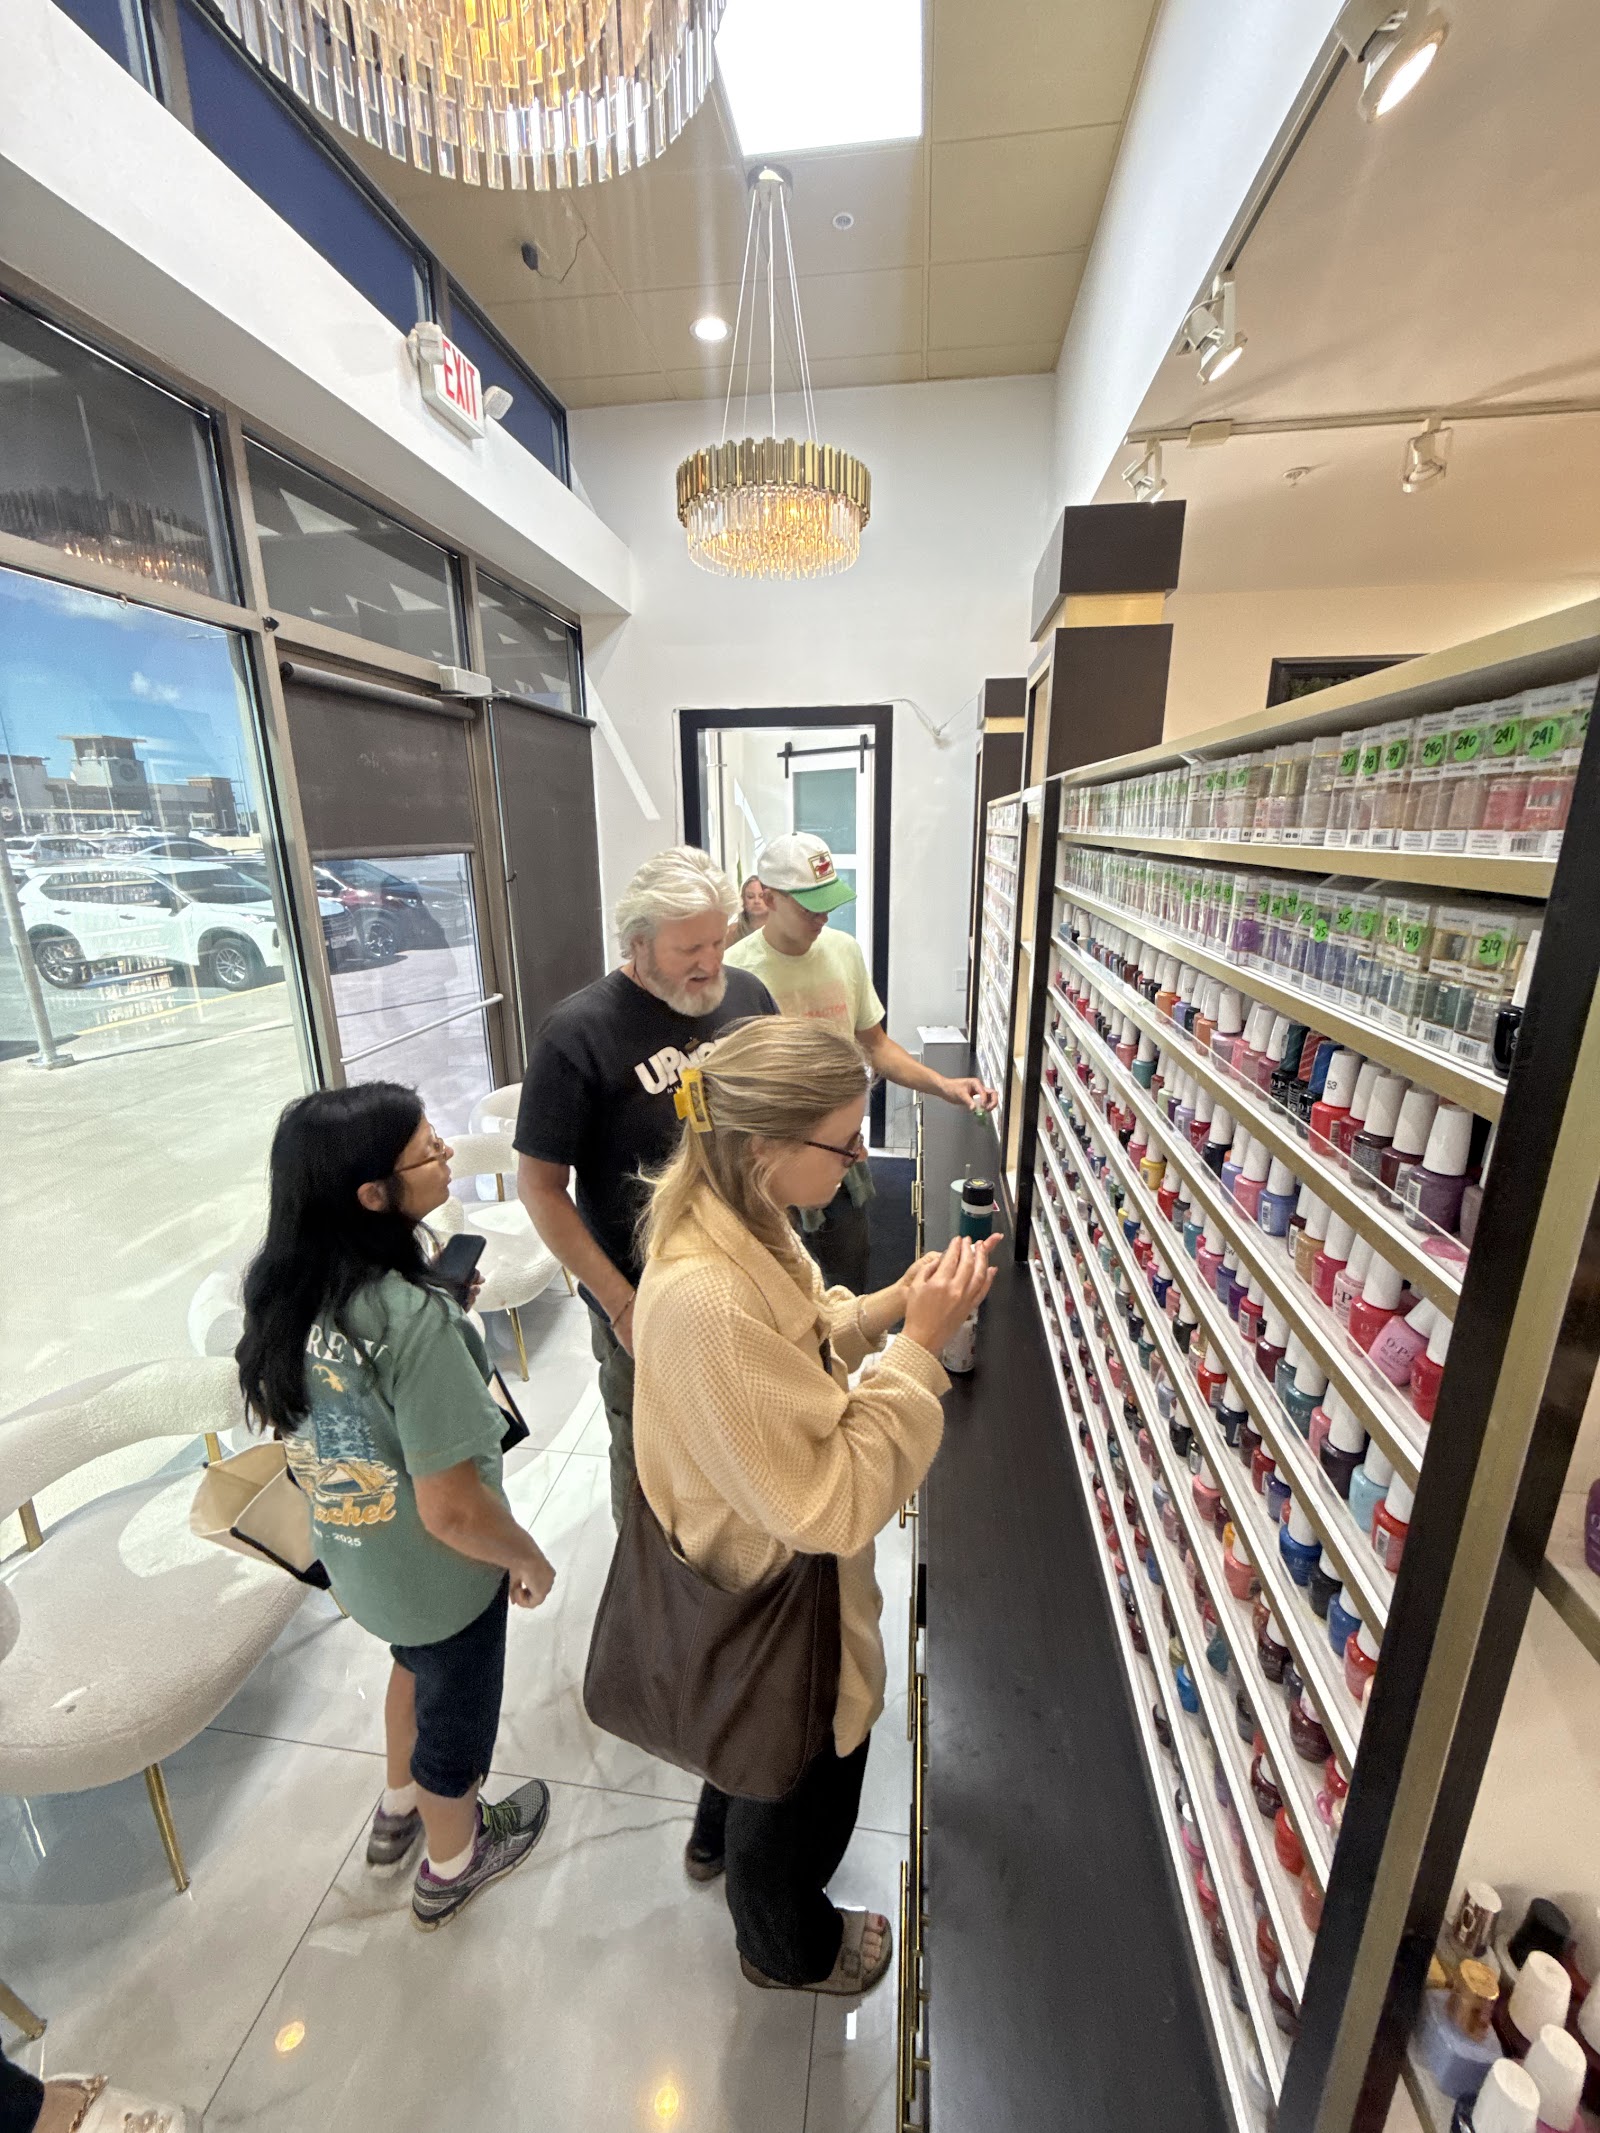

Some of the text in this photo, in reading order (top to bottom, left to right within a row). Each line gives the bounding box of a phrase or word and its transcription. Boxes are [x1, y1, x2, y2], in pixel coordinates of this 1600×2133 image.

[442, 338, 477, 421] EXIT
[1454, 735, 1478, 750] 290
[1493, 726, 1515, 745] 291
[1529, 726, 1554, 749] 291
[1478, 939, 1502, 956] 319
[1326, 1080, 1338, 1091] 53
[331, 1532, 362, 1547] 2025
